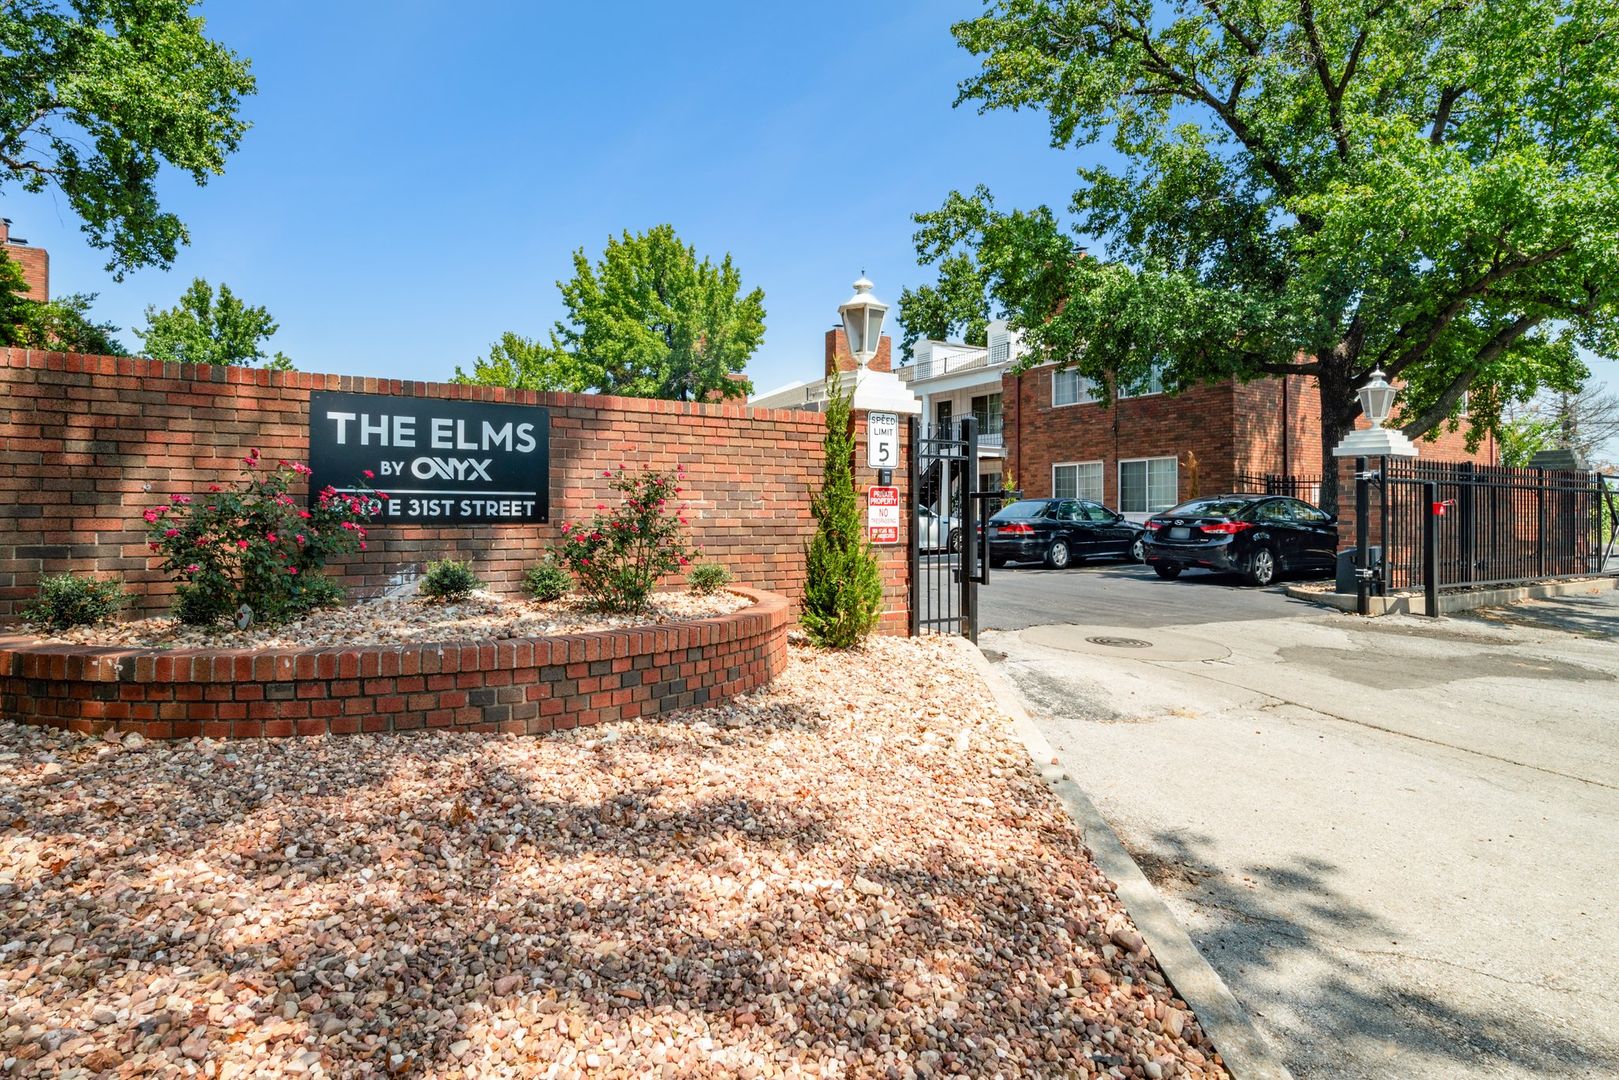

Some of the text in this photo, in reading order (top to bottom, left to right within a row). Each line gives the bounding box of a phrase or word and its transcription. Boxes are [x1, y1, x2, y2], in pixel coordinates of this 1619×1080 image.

[871, 416, 896, 426] SPEED
[326, 411, 537, 453] THE ELMS
[873, 428, 893, 436] LIMIT
[878, 442, 890, 462] 5
[380, 456, 493, 482] BY ONYX
[388, 499, 401, 516] E
[407, 498, 455, 516] 31ST
[459, 499, 536, 517] STREET
[870, 497, 897, 505] PROPERTY
[879, 508, 889, 518] NO
